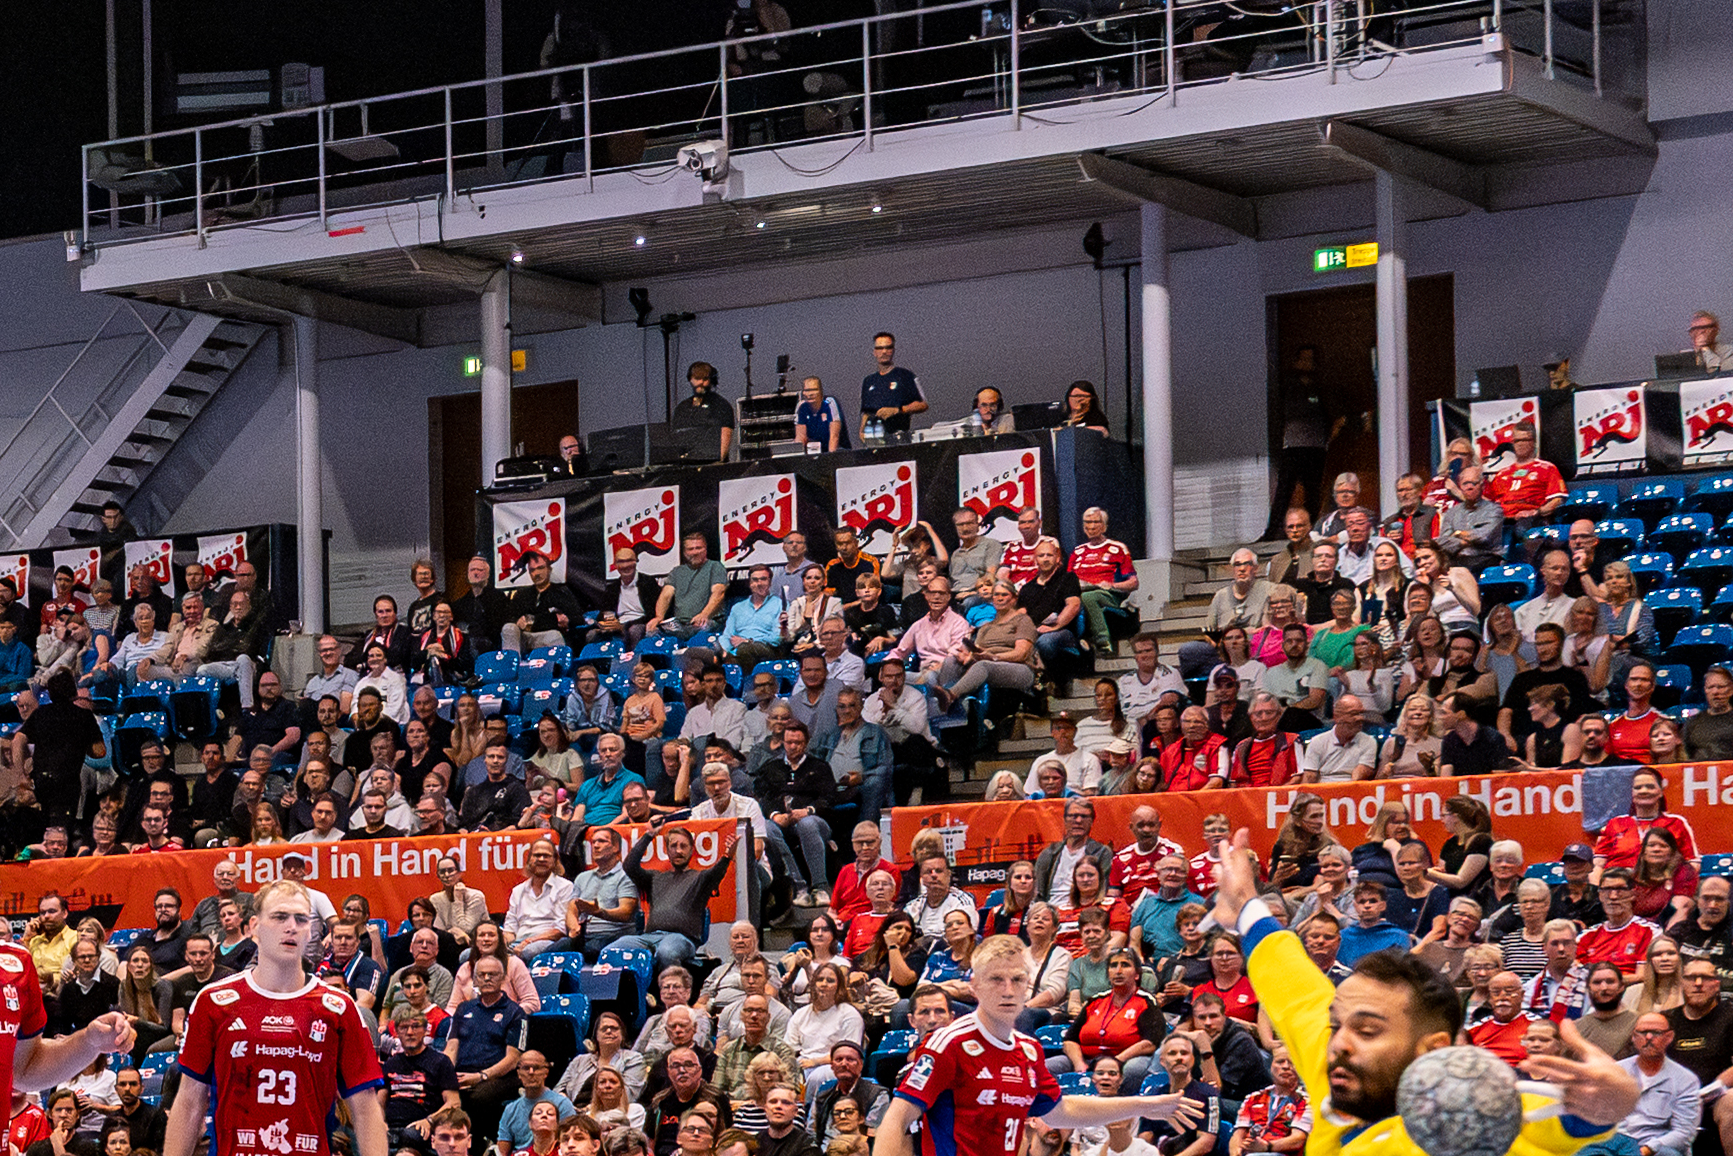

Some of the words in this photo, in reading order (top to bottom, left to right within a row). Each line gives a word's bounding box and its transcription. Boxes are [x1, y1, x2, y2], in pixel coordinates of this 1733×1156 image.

[1579, 390, 1641, 458] NRJ
[841, 480, 895, 510] ENERGY
[842, 466, 912, 530] NRJ
[964, 467, 1019, 498] ENERGY
[608, 504, 659, 533] ENERGY
[723, 491, 775, 522] ENERGY
[723, 478, 792, 561] NRJ
[498, 502, 562, 581] NRJ
[608, 490, 674, 572] NRJ
[73, 550, 99, 587] RJ
[331, 846, 361, 878] in
[374, 838, 466, 876] Hand
[479, 836, 527, 871] für
[261, 1016, 282, 1024] AOK
[257, 1069, 297, 1105] 23
[1005, 1118, 1019, 1151] 21
